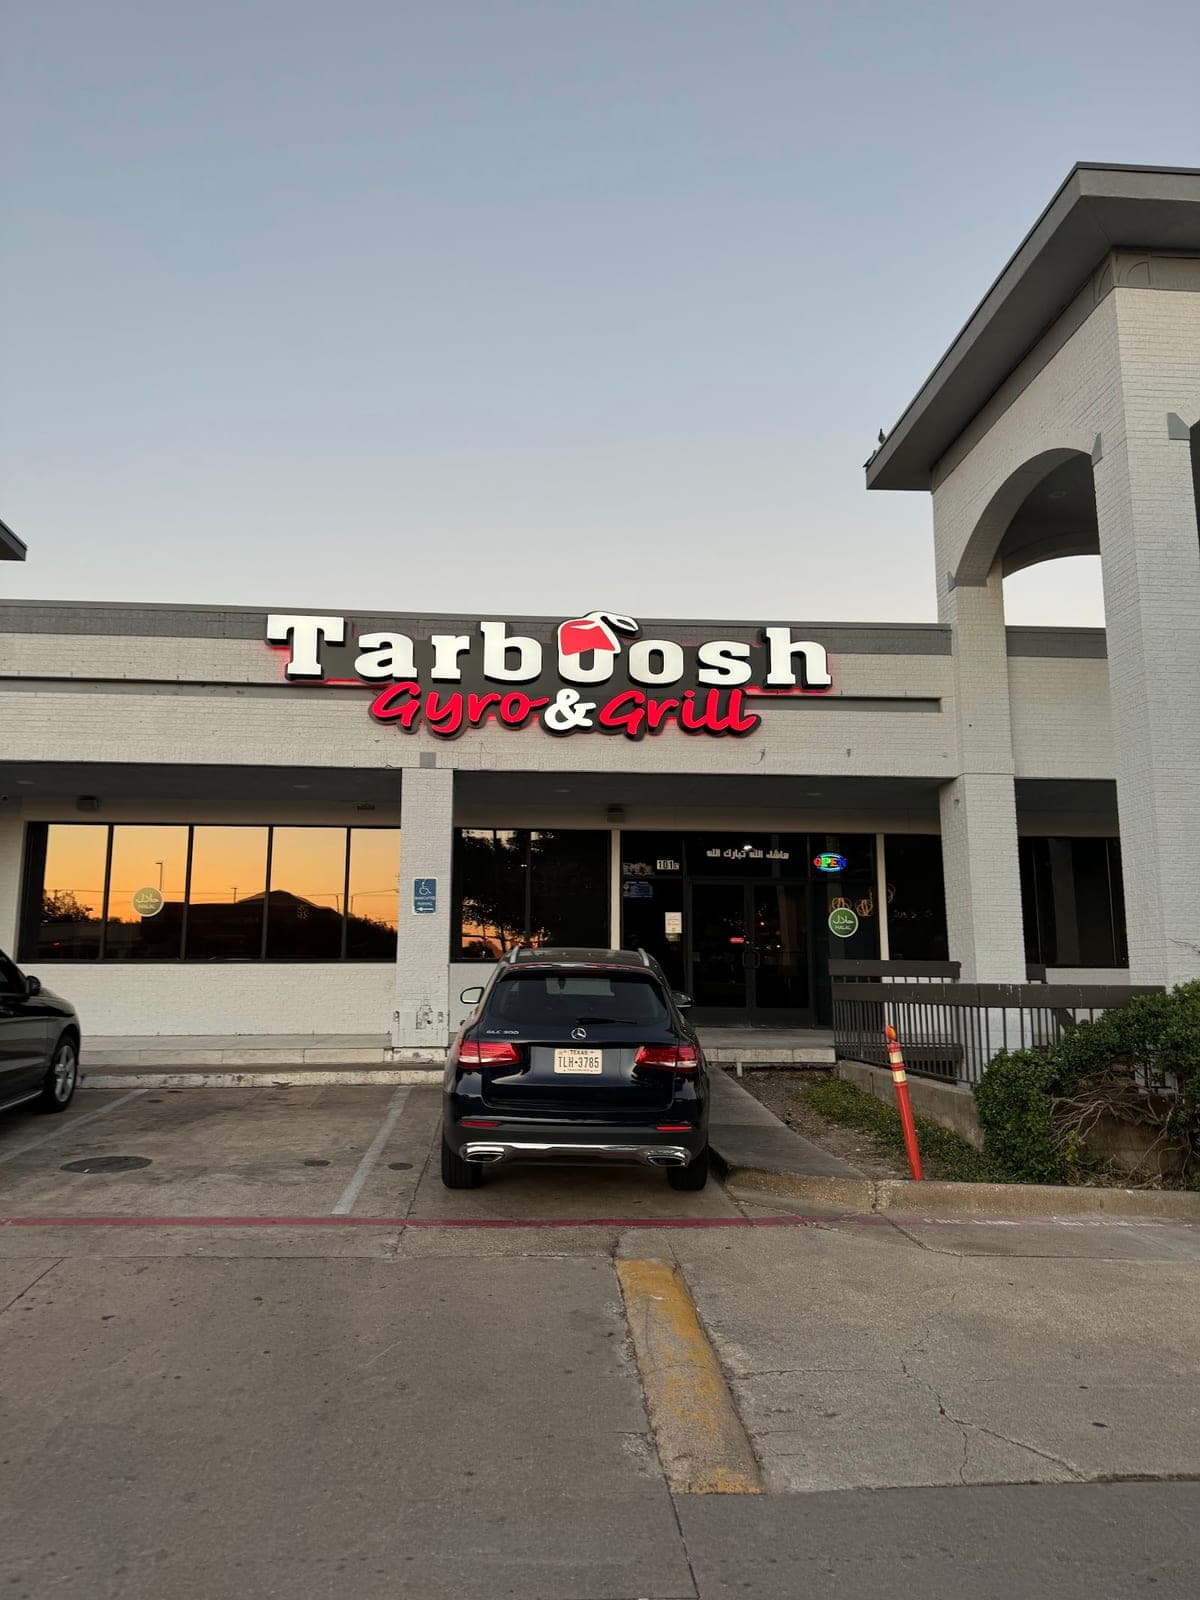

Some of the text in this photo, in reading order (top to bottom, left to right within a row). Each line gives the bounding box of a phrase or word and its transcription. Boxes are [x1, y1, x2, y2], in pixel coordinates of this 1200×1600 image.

[266, 614, 831, 686] Tarboosh
[372, 682, 758, 736] Gyro & Grill
[813, 857, 847, 868] OPEN
